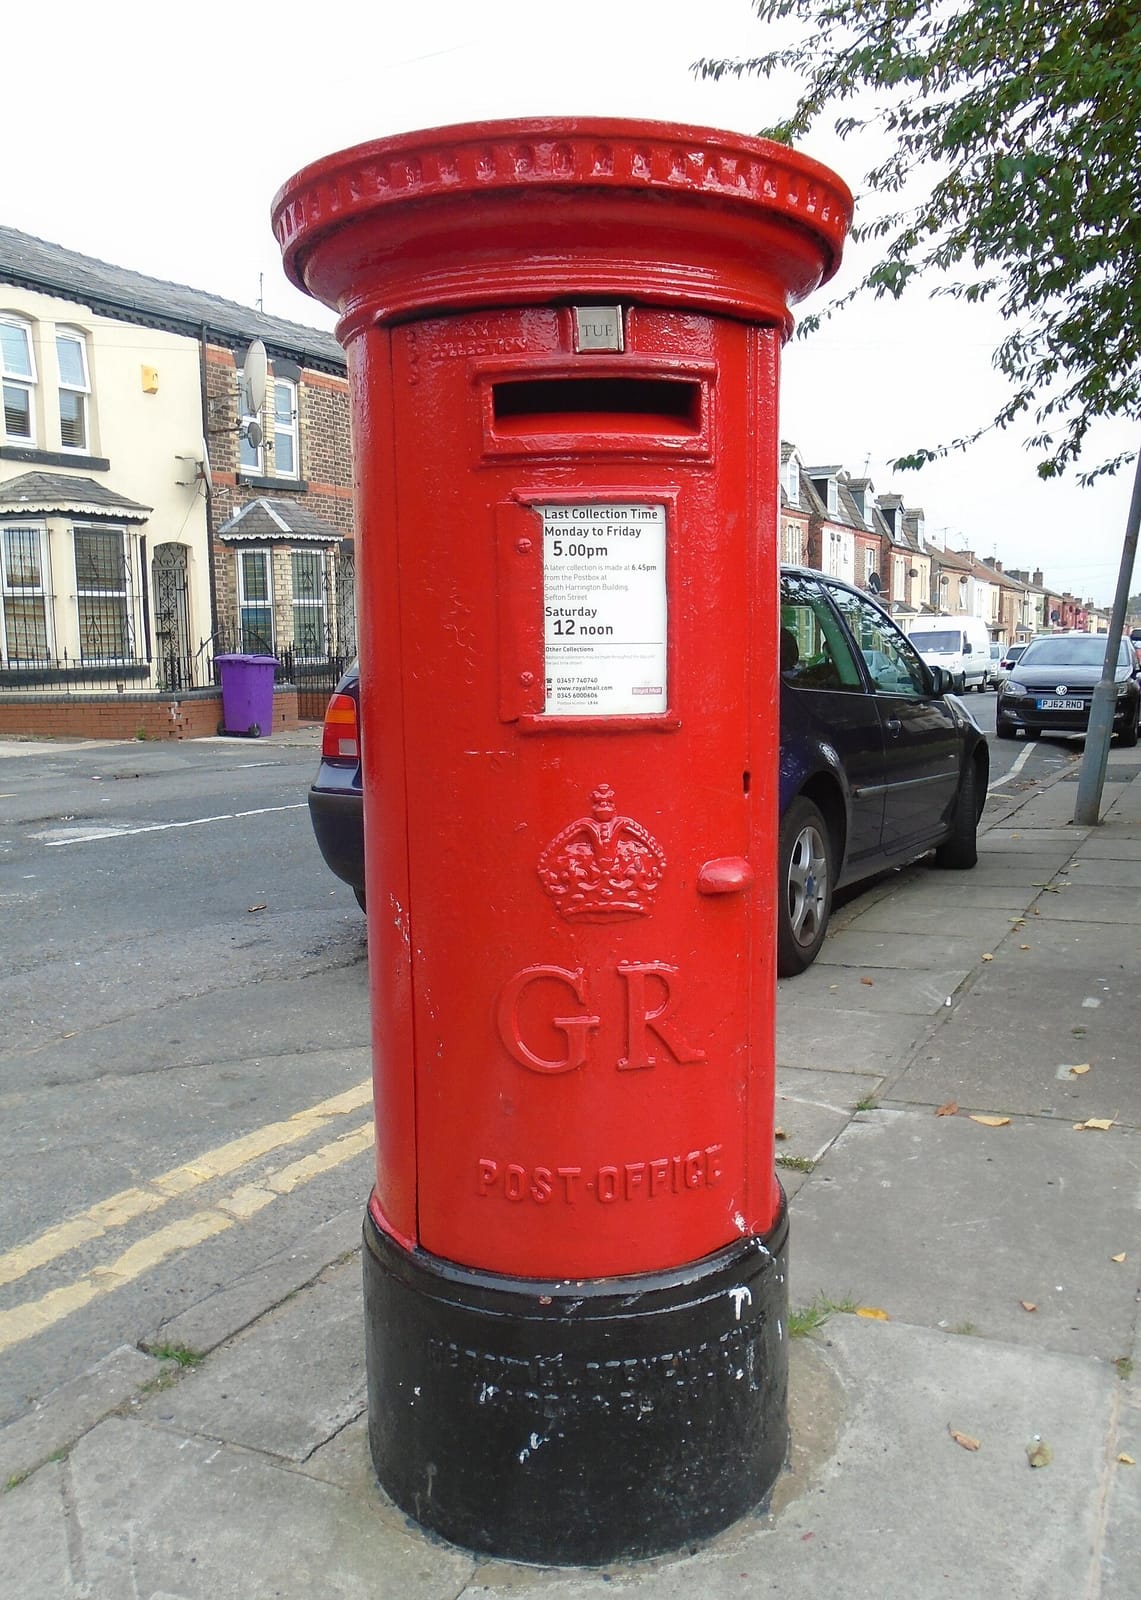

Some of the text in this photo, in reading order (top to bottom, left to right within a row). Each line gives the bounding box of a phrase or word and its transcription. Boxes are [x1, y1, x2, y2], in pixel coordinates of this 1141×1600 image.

[582, 325, 613, 336] TUE
[544, 509, 657, 519] Last Collection Time
[545, 527, 589, 538] Monday
[607, 526, 641, 538] Friday
[553, 541, 607, 559] 5.00pm
[546, 607, 597, 618] Saturday
[553, 620, 613, 635] 12 noon
[497, 960, 707, 1073] GR
[478, 1144, 722, 1204] POST OFFICE
